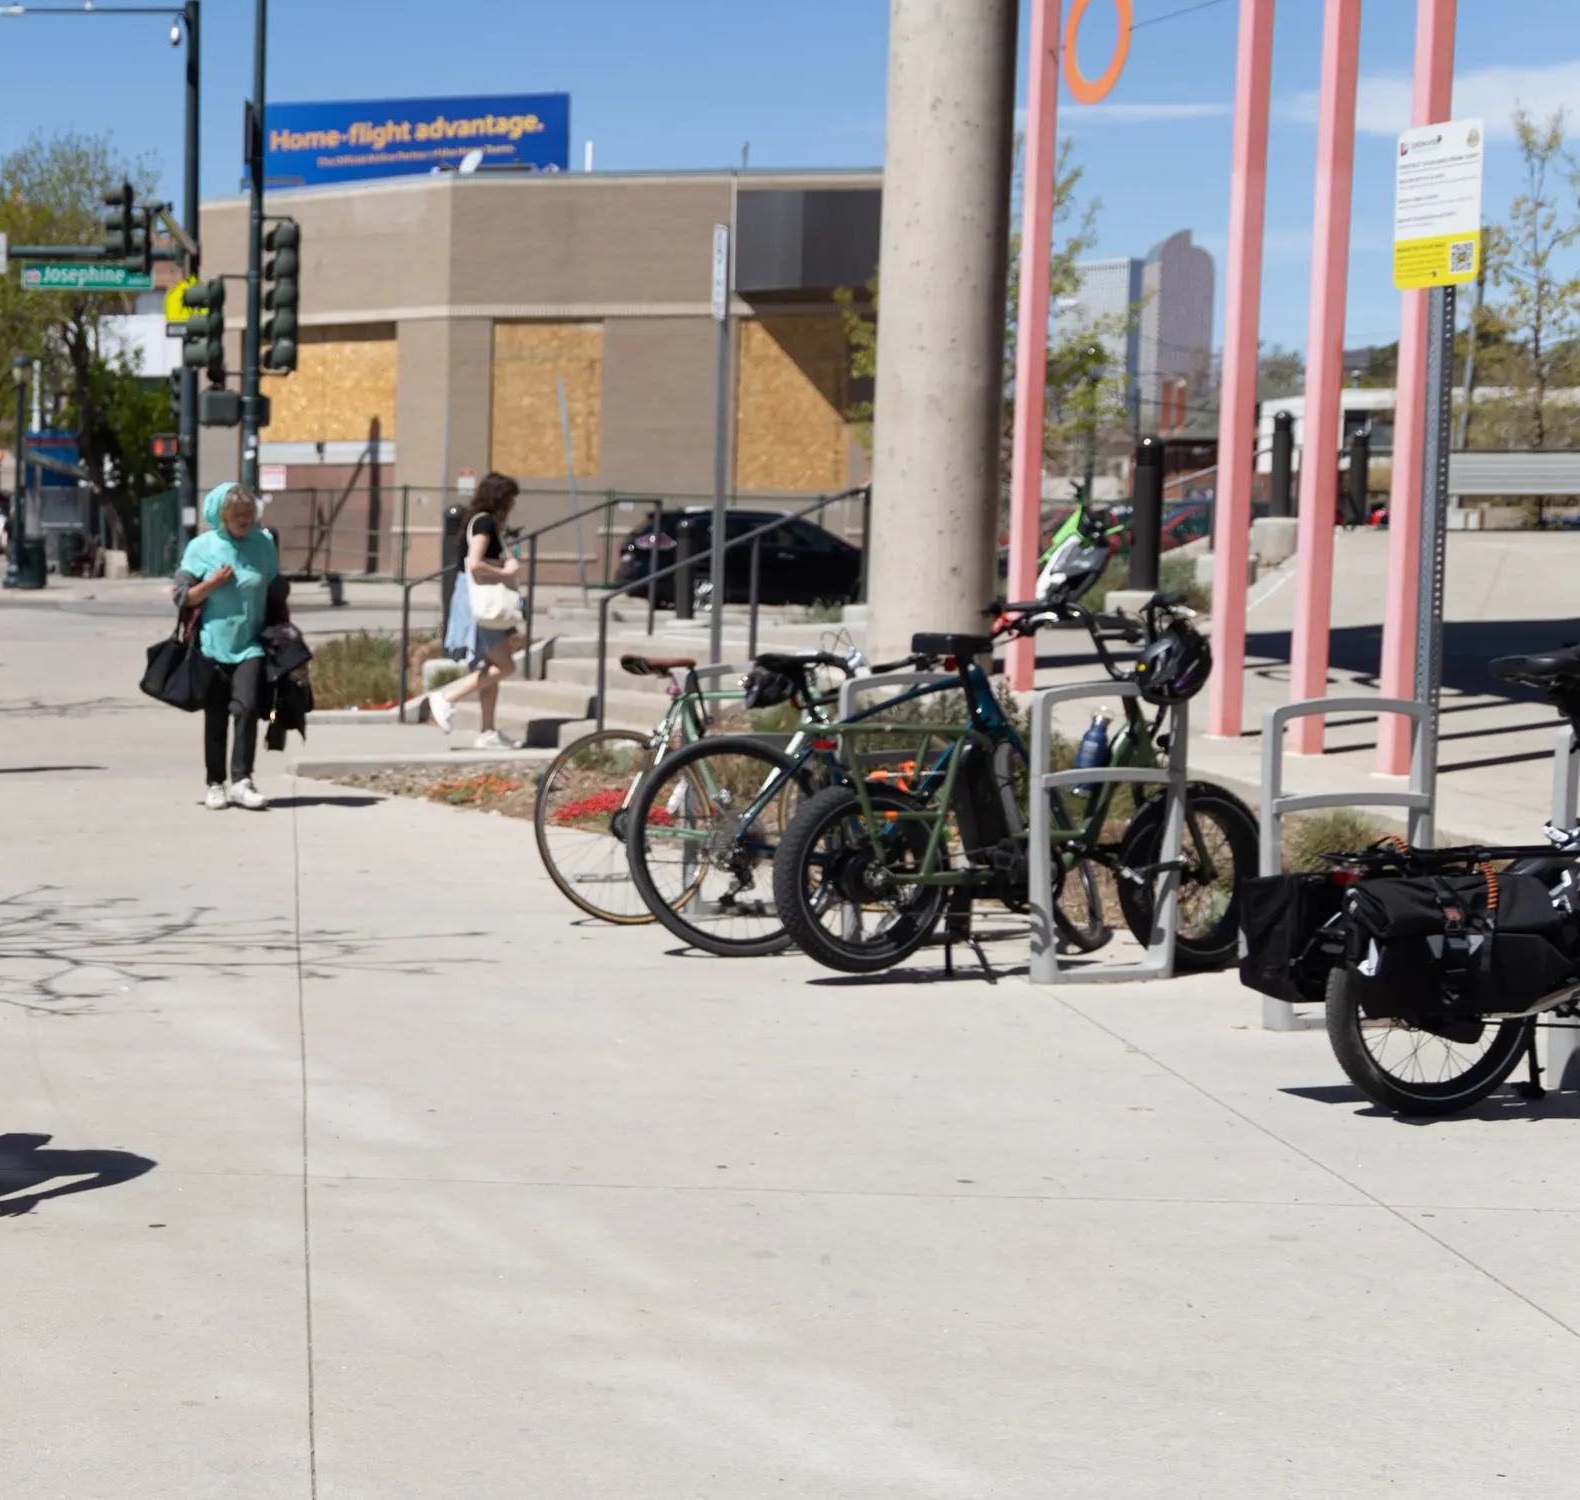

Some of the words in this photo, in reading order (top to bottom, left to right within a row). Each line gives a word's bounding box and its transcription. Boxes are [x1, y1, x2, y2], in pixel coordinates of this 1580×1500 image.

[270, 120, 411, 150] Home-flight
[414, 113, 544, 140] advantage.
[43, 265, 125, 287] Josephine
